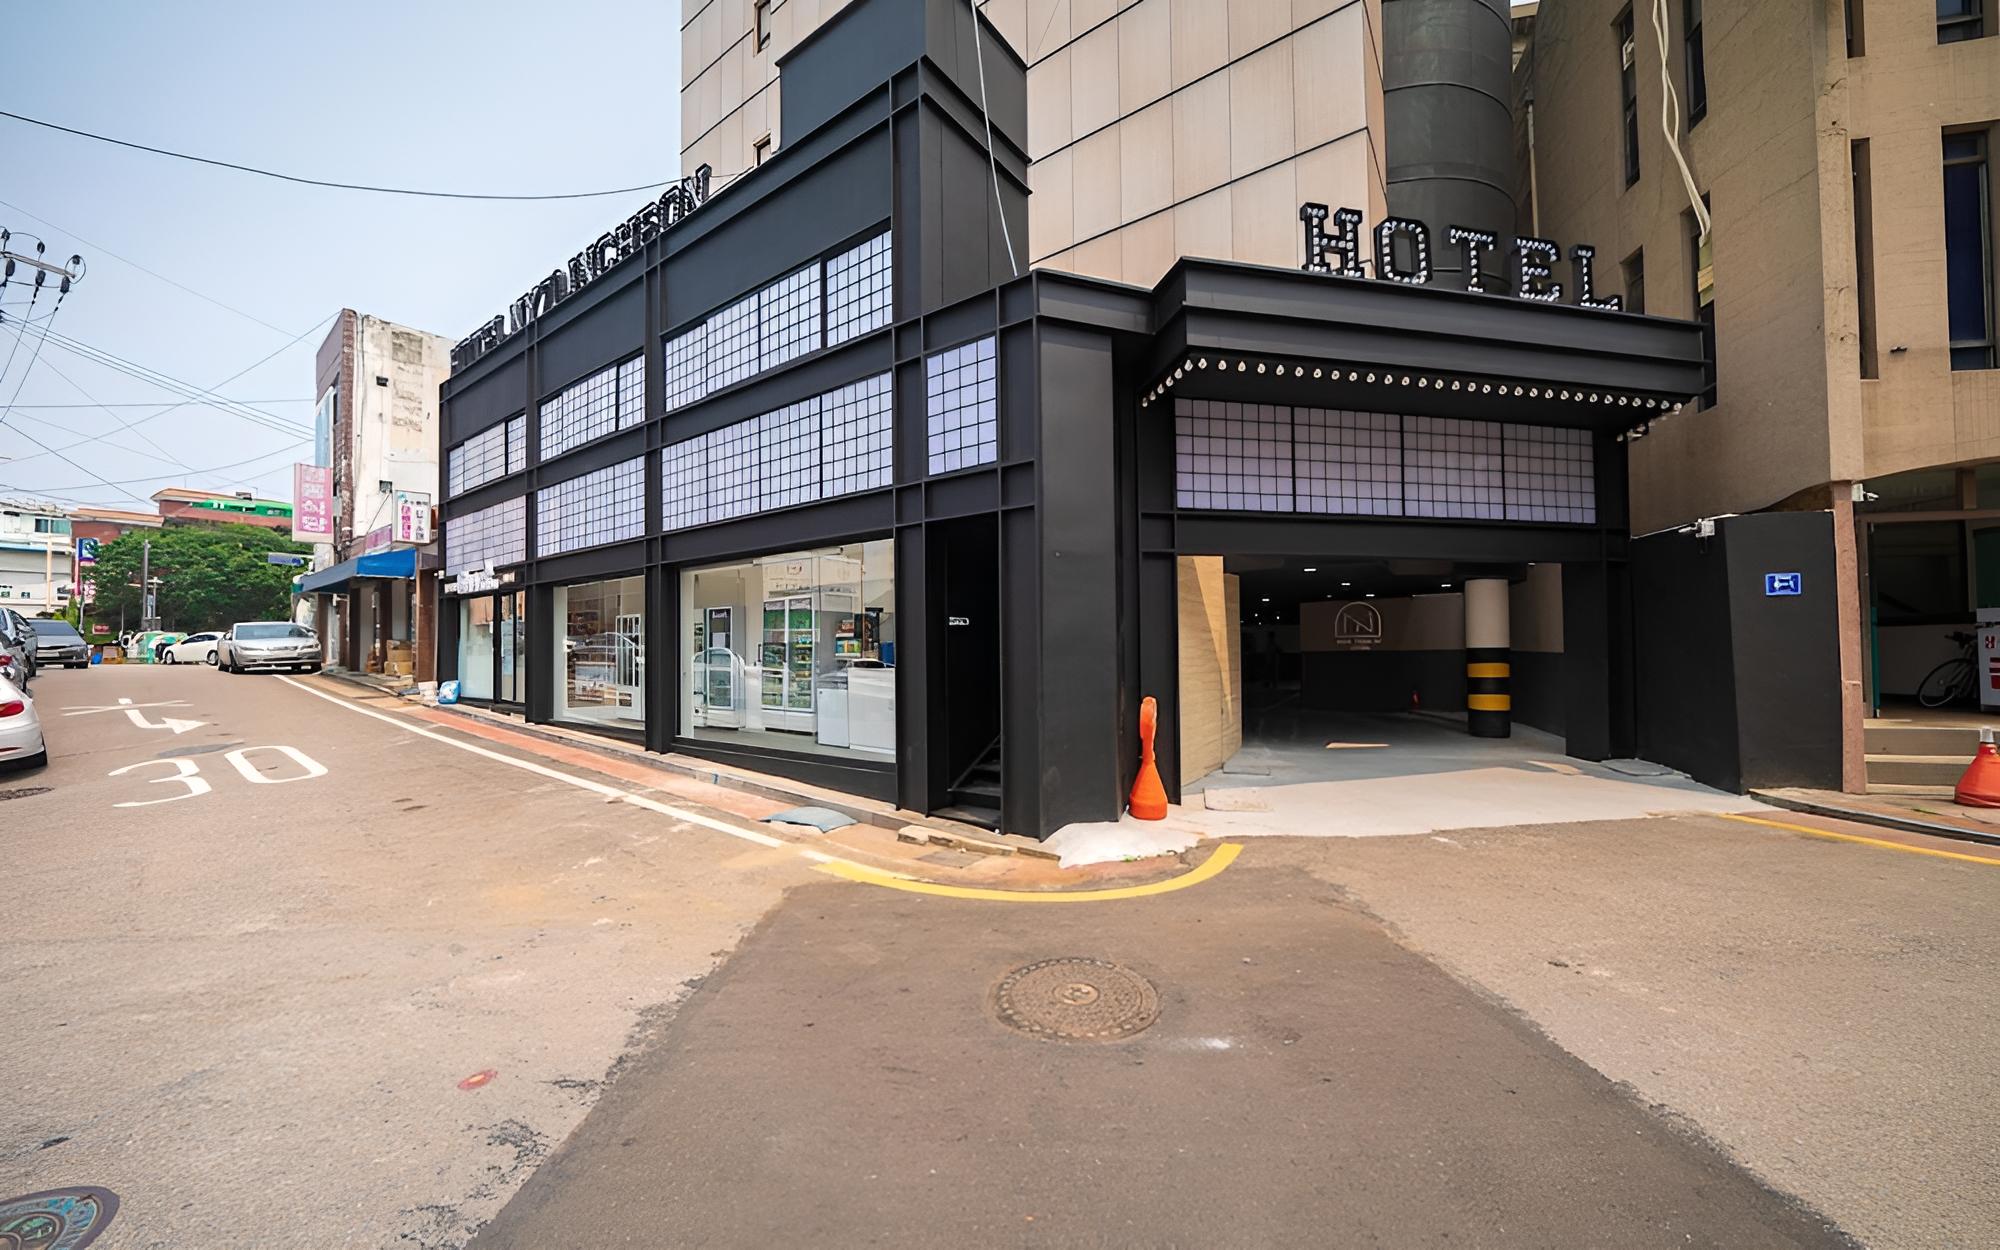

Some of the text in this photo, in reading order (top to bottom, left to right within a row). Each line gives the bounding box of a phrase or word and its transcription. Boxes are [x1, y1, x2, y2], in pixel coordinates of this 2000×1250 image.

[567, 163, 712, 295] INCHEON
[1300, 201, 1624, 312] HOTEL
[107, 745, 329, 808] 30
